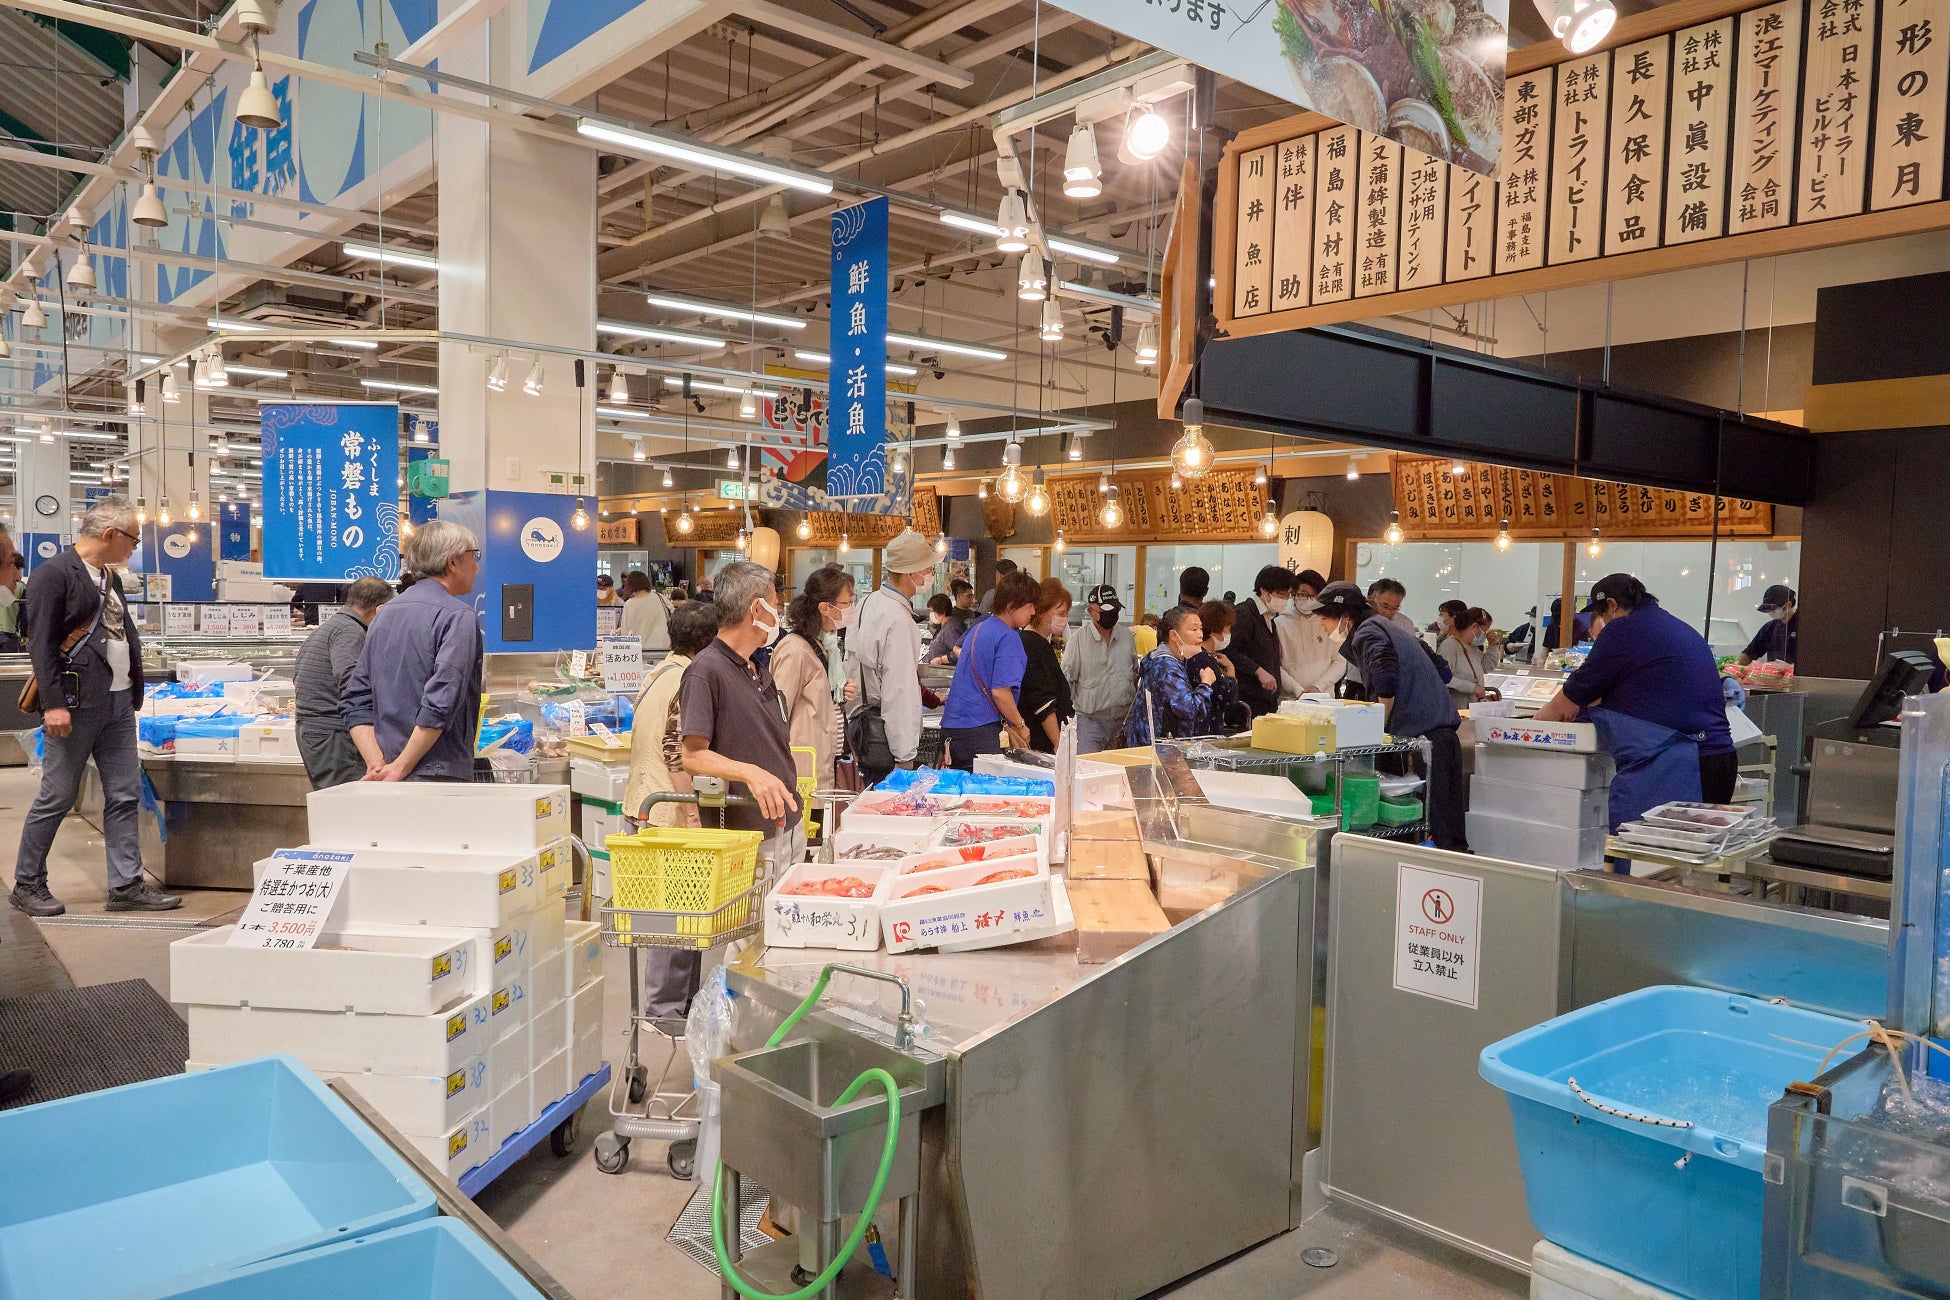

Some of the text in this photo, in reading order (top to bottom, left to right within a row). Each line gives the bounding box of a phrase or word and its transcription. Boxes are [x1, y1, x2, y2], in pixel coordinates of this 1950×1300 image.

[1513, 81, 1540, 164] 東部ガス
[1752, 13, 1784, 173] 浪江マーケティング
[1891, 0, 1932, 198] 形の東月
[1366, 136, 1390, 249] 又蒲鉾製造
[1567, 111, 1589, 253] トライビート
[1619, 49, 1656, 242] 長久保食品
[1242, 155, 1264, 310] 川井魚店
[1322, 137, 1345, 258] 福島食材
[340, 430, 366, 549] 常磐もの
[367, 437, 381, 497] ふくしま
[605, 653, 639, 663] 活あわび
[260, 902, 318, 915] ご贈答用に
[282, 864, 333, 877] 千葉産他
[1408, 925, 1465, 944] STAFF ONLY
[1408, 942, 1464, 966] 従業員以外
[1413, 959, 1458, 980] 立入禁止
